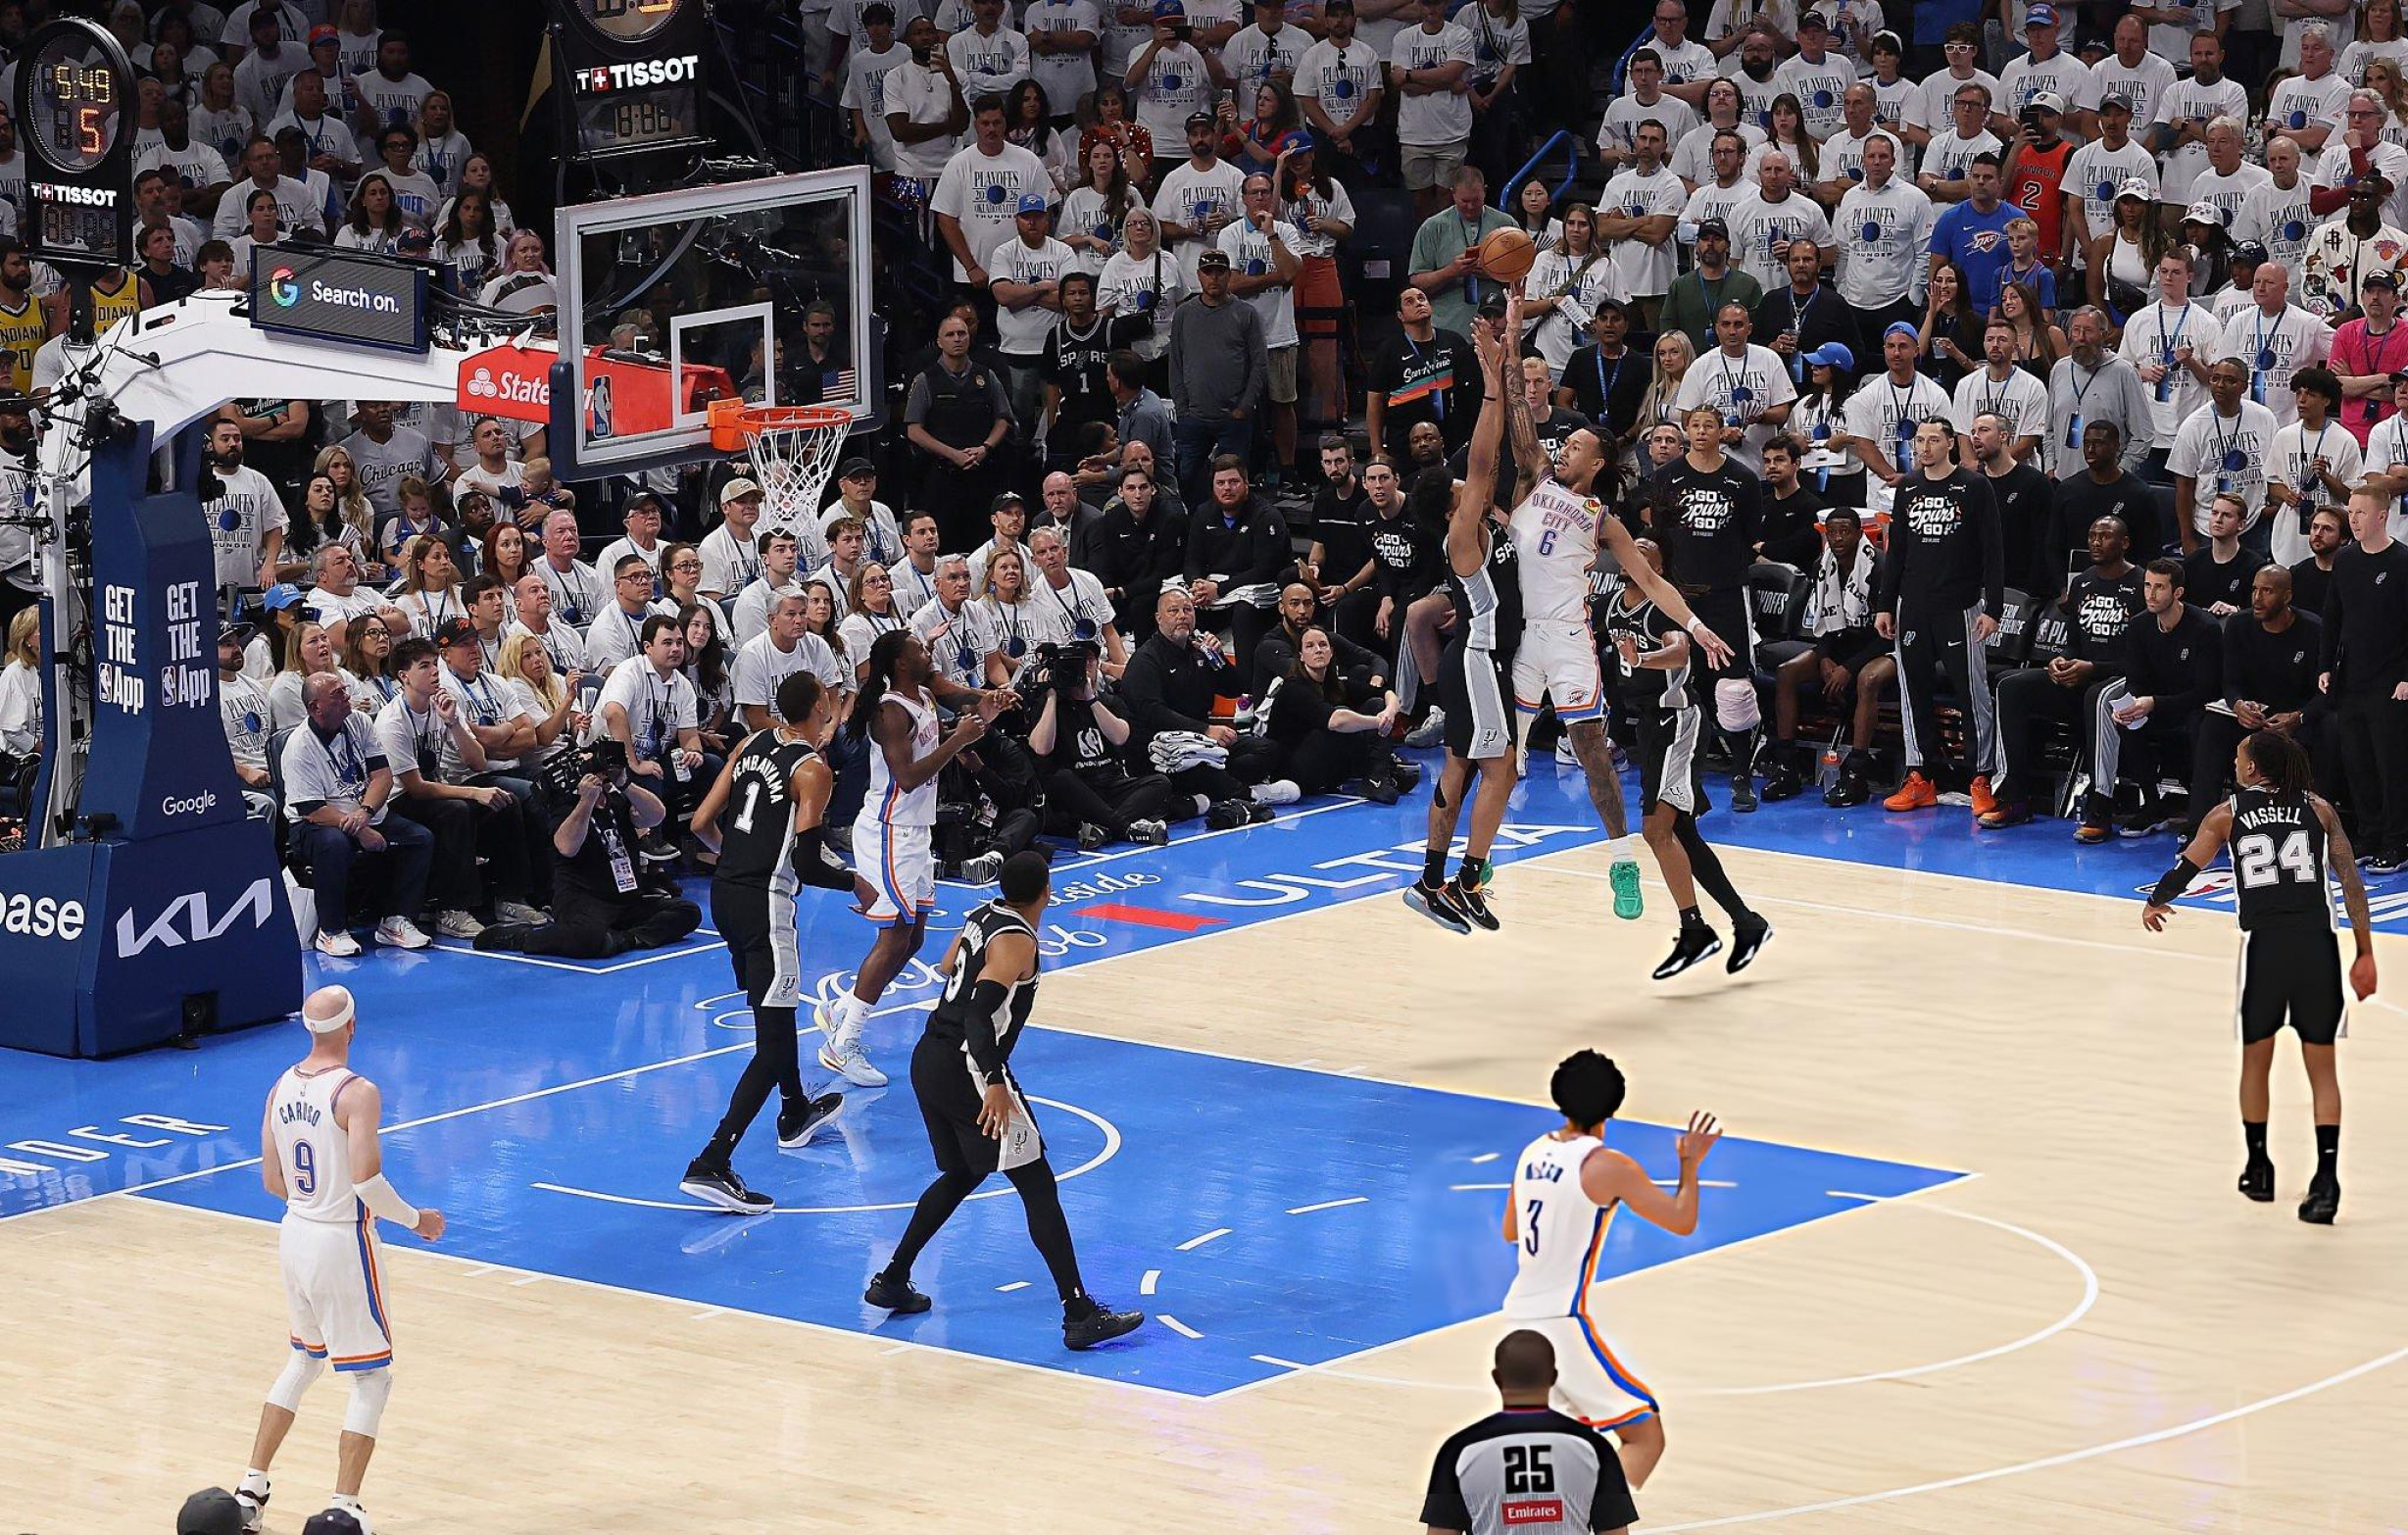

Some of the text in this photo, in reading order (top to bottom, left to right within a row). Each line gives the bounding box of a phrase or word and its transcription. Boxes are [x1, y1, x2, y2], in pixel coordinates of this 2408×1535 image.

[611, 55, 699, 89] TISSOT
[1152, 61, 1195, 77] PLAYOFFS
[56, 65, 111, 104] 5:49
[1799, 77, 1843, 95] PLAYOFFS
[2014, 75, 2057, 91] PLAYOFFS
[1744, 96, 1768, 113] PLAY
[2135, 102, 2145, 113] 26
[79, 107, 100, 154] 5
[974, 171, 1020, 187] PLAYOFFS
[54, 185, 117, 207] TISSOT
[974, 190, 1019, 202] 20 26
[2019, 179, 2044, 210] 2
[1851, 207, 1895, 224] PLAYOFFS
[1883, 227, 1893, 239] 26
[312, 280, 370, 309] Search
[373, 287, 400, 314] on.
[1582, 292, 1593, 303] 26
[98, 305, 135, 322] DIANA
[0, 323, 42, 345] NDIAN
[2244, 333, 2292, 353] PLYOFFS
[2280, 357, 2291, 369] 26
[498, 371, 550, 405] State
[1079, 372, 1090, 393] 1
[1718, 393, 1731, 407] 20
[1882, 404, 1931, 421] PLYOFFS
[1884, 425, 1898, 439] 20
[2251, 453, 2262, 465] 26
[360, 462, 420, 486] Chicago
[1695, 489, 1718, 503] GO
[1924, 497, 1944, 509] GO
[1677, 494, 1729, 527] Spurs
[1908, 502, 1955, 529] Spurs
[1542, 513, 1571, 532] CITY
[1693, 517, 1716, 529] GO
[1923, 524, 1941, 535] GO
[1374, 537, 1412, 560] Spurs
[1384, 533, 1400, 545] GO
[1538, 530, 1556, 557] 6
[1389, 558, 1404, 568] GO
[105, 584, 135, 623] GET
[167, 581, 199, 621] GET
[550, 590, 594, 616] PLAOFFS
[1755, 590, 1790, 616] YOFFS
[2095, 596, 2115, 608] GO
[1057, 597, 1097, 632] PLYOFFS
[2077, 601, 2125, 627] Spurs
[2091, 623, 2111, 635] GO
[106, 624, 136, 665] THE
[168, 621, 202, 661] THE
[113, 666, 144, 715] App
[178, 665, 211, 708] App
[163, 789, 217, 816] Google
[734, 781, 760, 834] 1
[2238, 805, 2302, 831] VASSELL
[1178, 825, 1599, 908] ULTRA
[2238, 830, 2316, 889] 24
[278, 1101, 321, 1127] CARUSO
[293, 1138, 319, 1197] 9
[1525, 1199, 1543, 1257] 3
[1502, 1444, 1555, 1494] 25
[1507, 1503, 1557, 1521] Emirates
